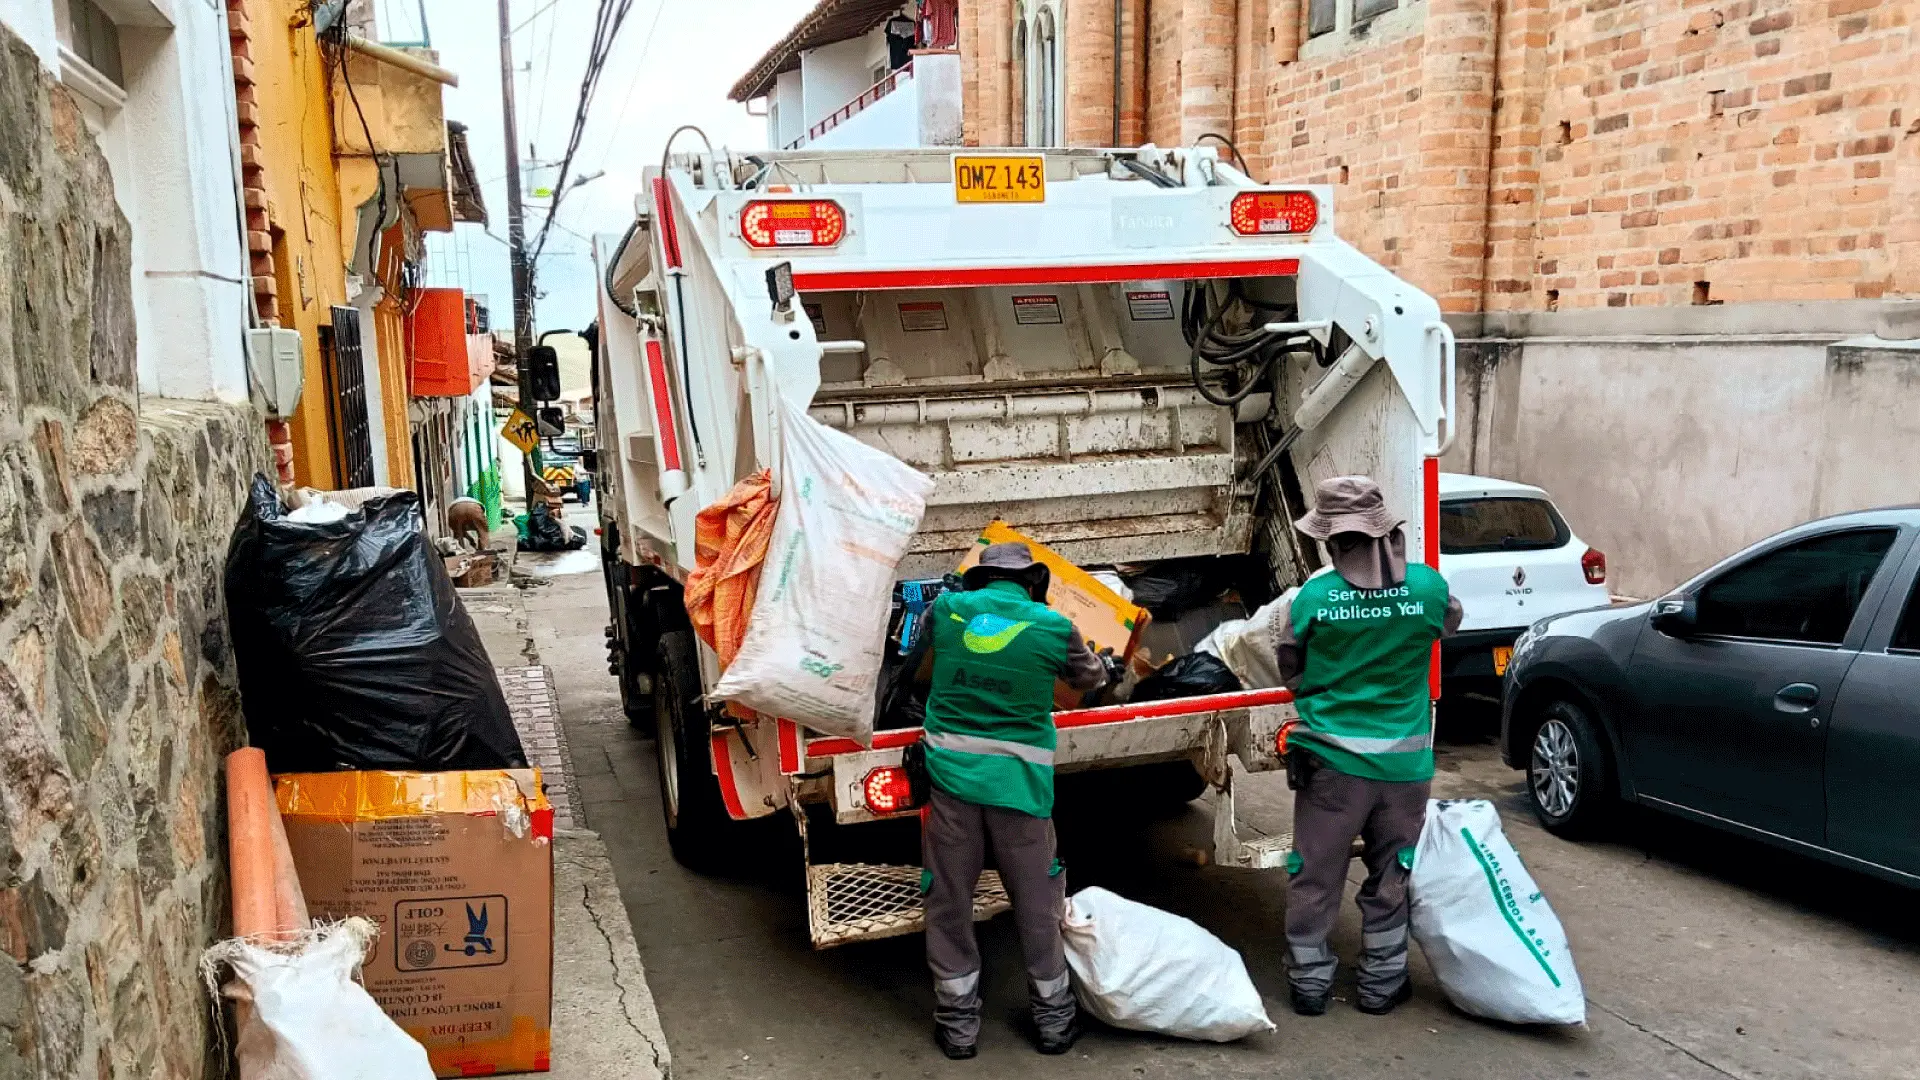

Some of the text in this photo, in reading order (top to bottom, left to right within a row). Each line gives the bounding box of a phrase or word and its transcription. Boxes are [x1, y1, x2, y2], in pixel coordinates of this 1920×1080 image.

[958, 165, 1041, 190] OMZ 143
[1327, 585, 1410, 602] Servicios
[1317, 601, 1425, 621] Públicos Yali
[951, 667, 1013, 695] Aseo
[404, 907, 444, 920] GOLF
[430, 1021, 492, 1037] KEEP DRY
